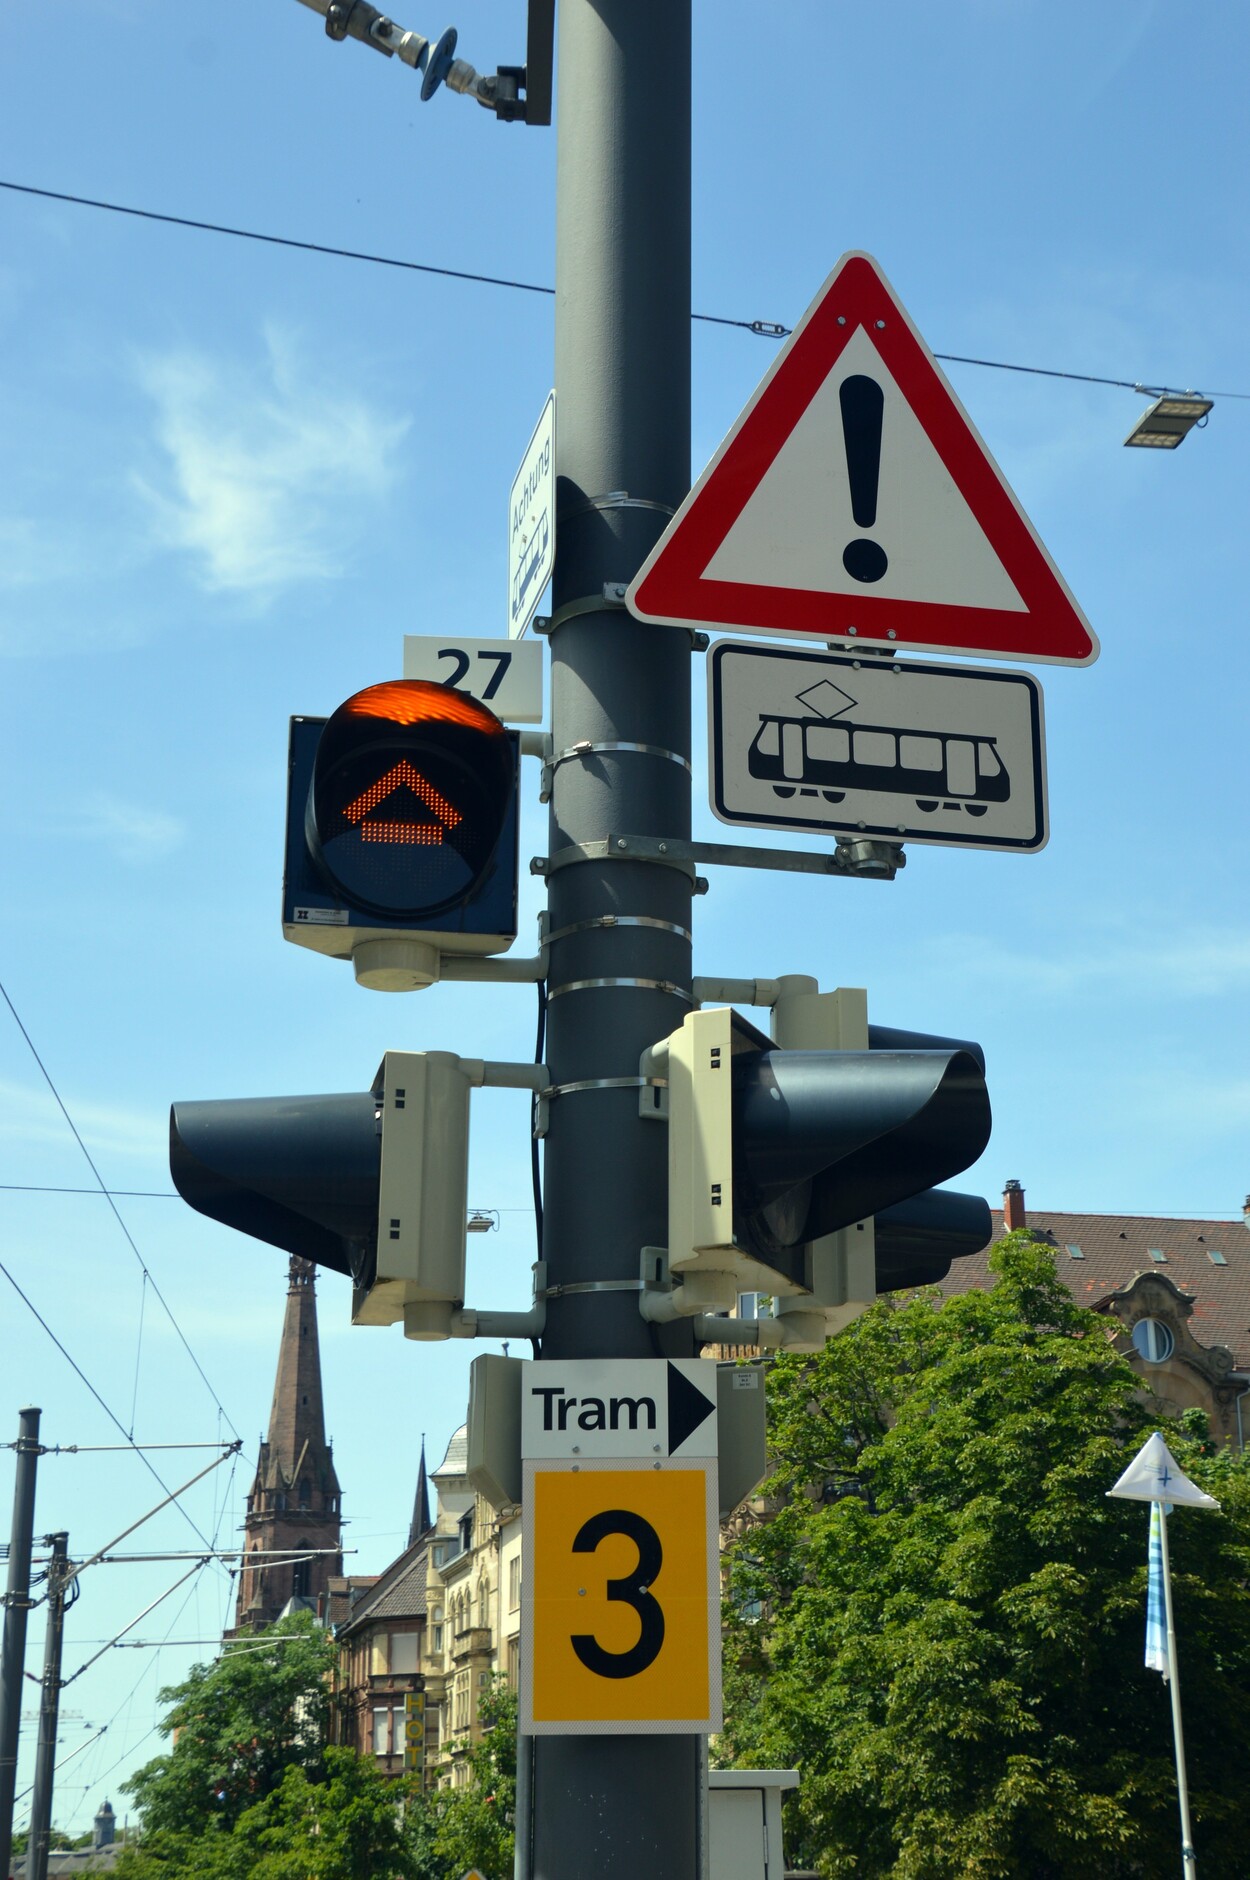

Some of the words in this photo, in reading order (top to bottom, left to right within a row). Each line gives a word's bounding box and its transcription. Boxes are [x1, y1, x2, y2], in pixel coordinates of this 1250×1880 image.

[512, 435, 550, 543] Achtung
[437, 648, 512, 700] 27
[531, 1387, 657, 1431] Tram
[570, 1509, 666, 1679] 3
